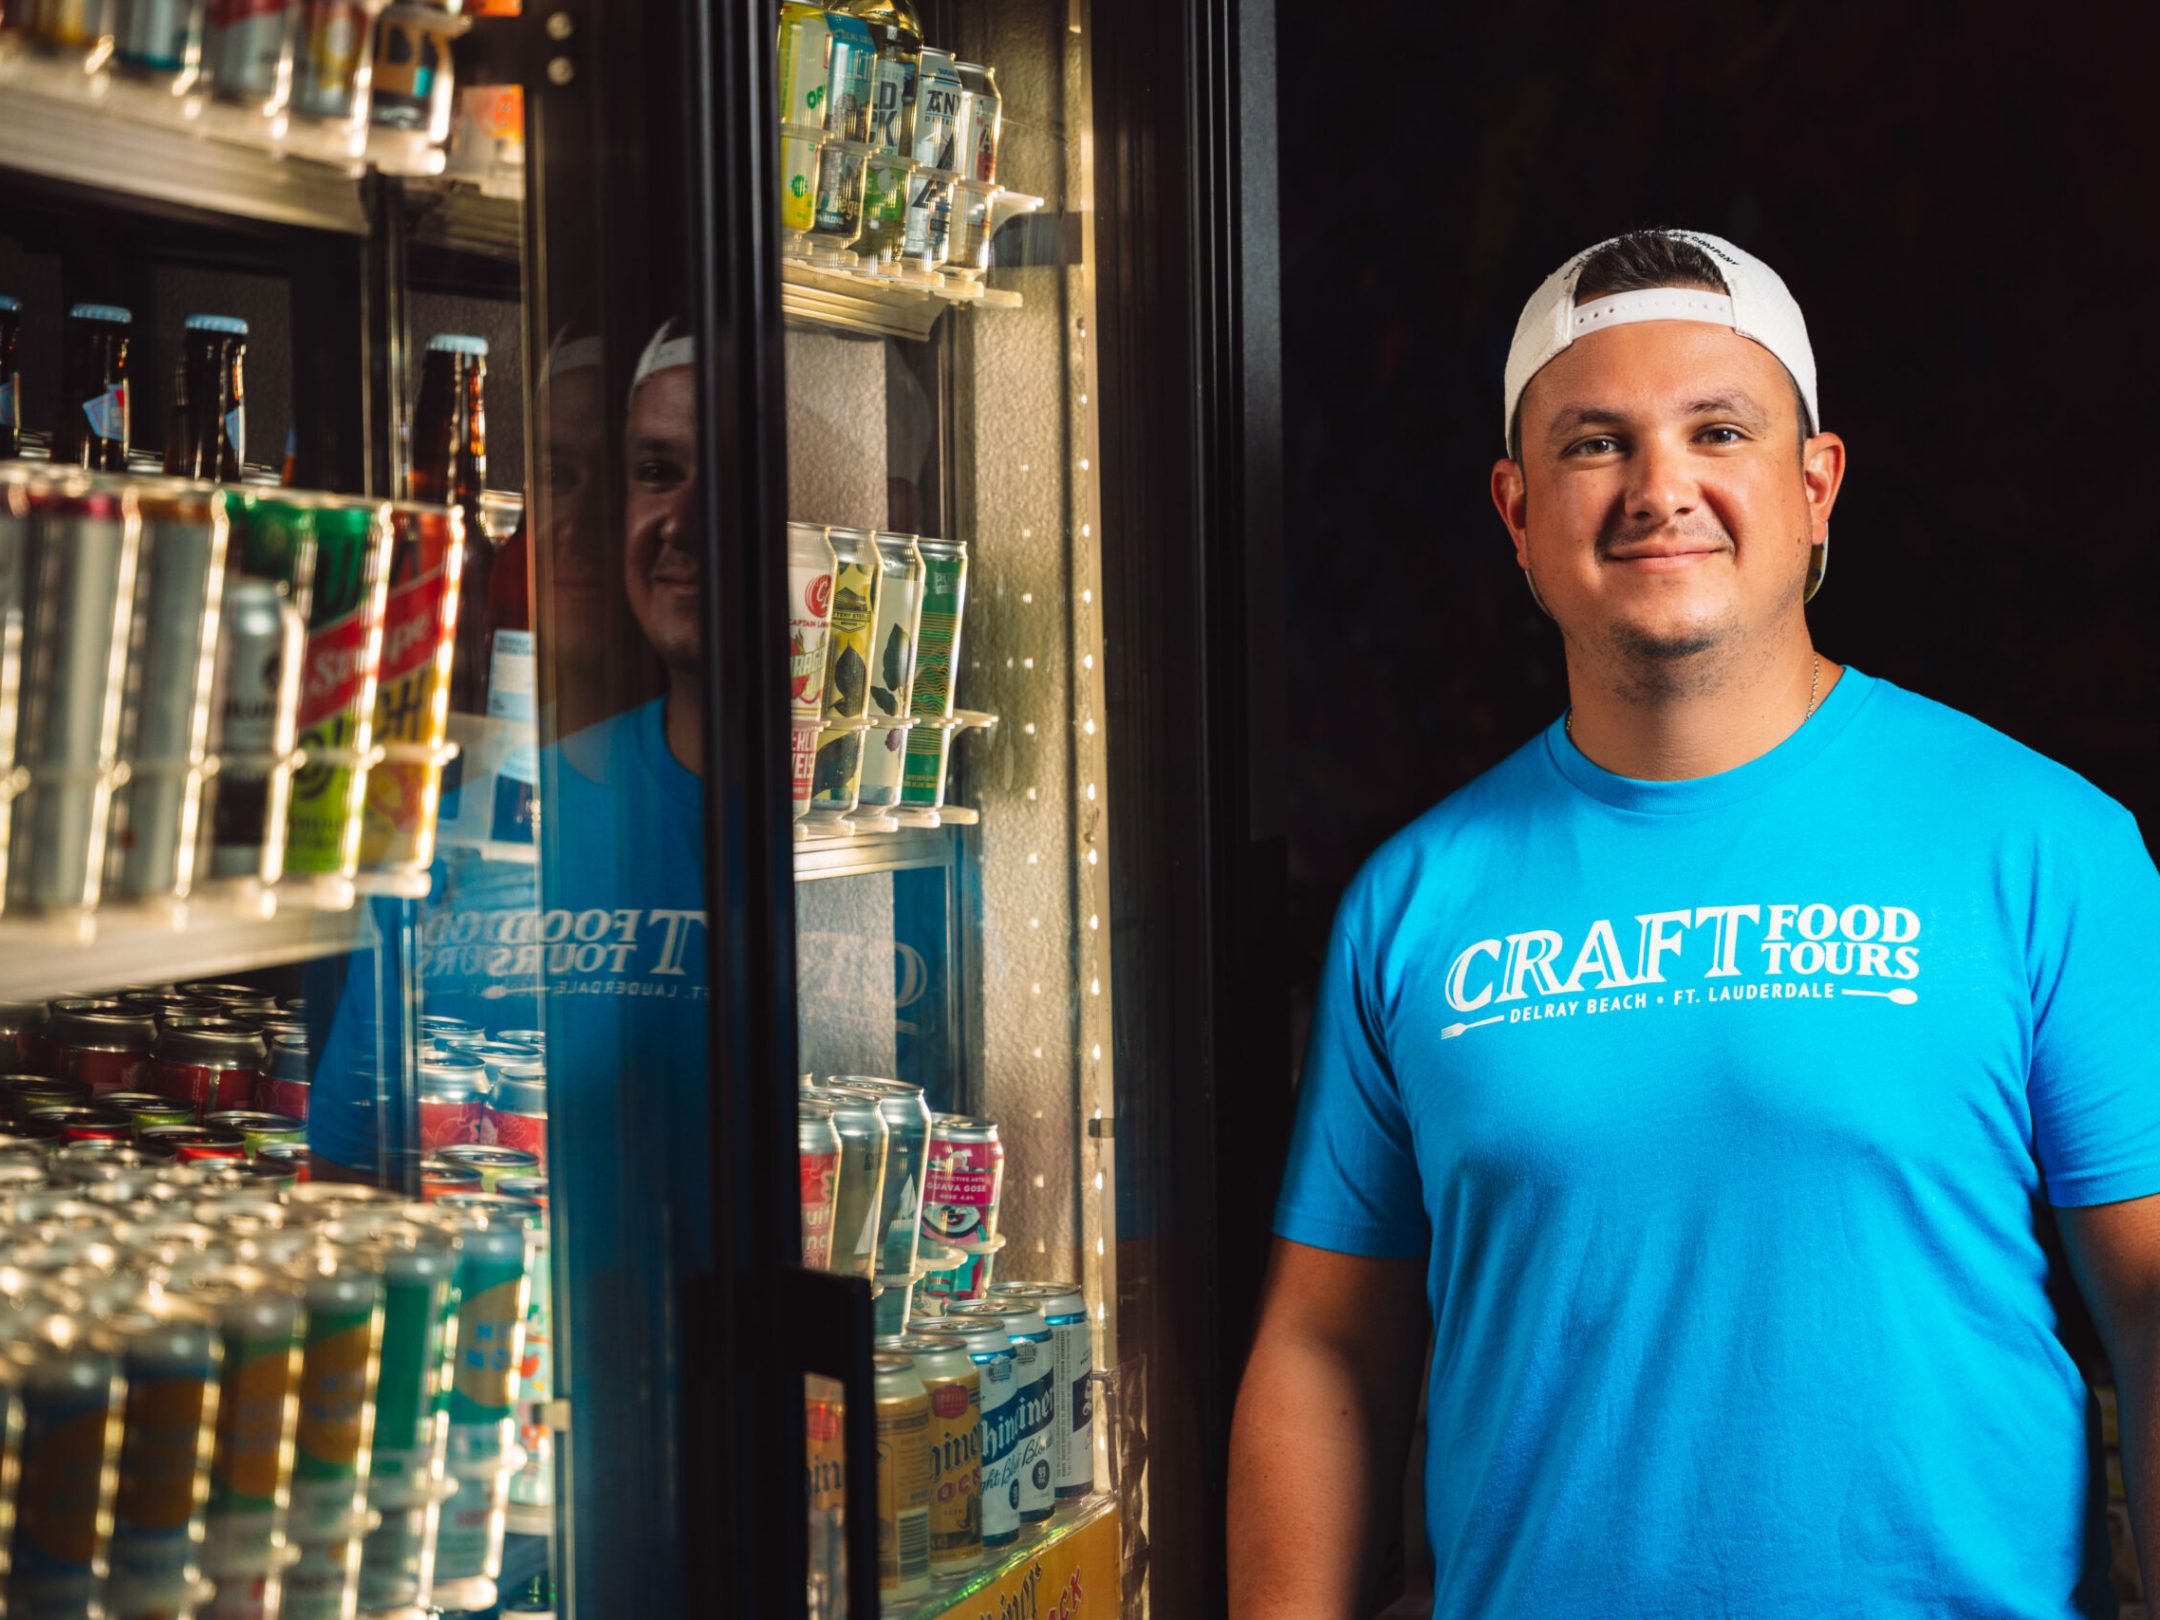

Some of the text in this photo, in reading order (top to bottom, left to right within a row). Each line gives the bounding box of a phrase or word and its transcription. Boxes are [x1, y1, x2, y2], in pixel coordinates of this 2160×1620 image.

[1691, 235, 1740, 266] COMPANY
[1444, 903, 1920, 1012] CRAFT FOOD
[1760, 941, 1920, 980] TOURS
[1508, 982, 1835, 1024] DELRAY BEACH FT. LAUDERDALE
[926, 1181, 987, 1193] GUAVA GOSE
